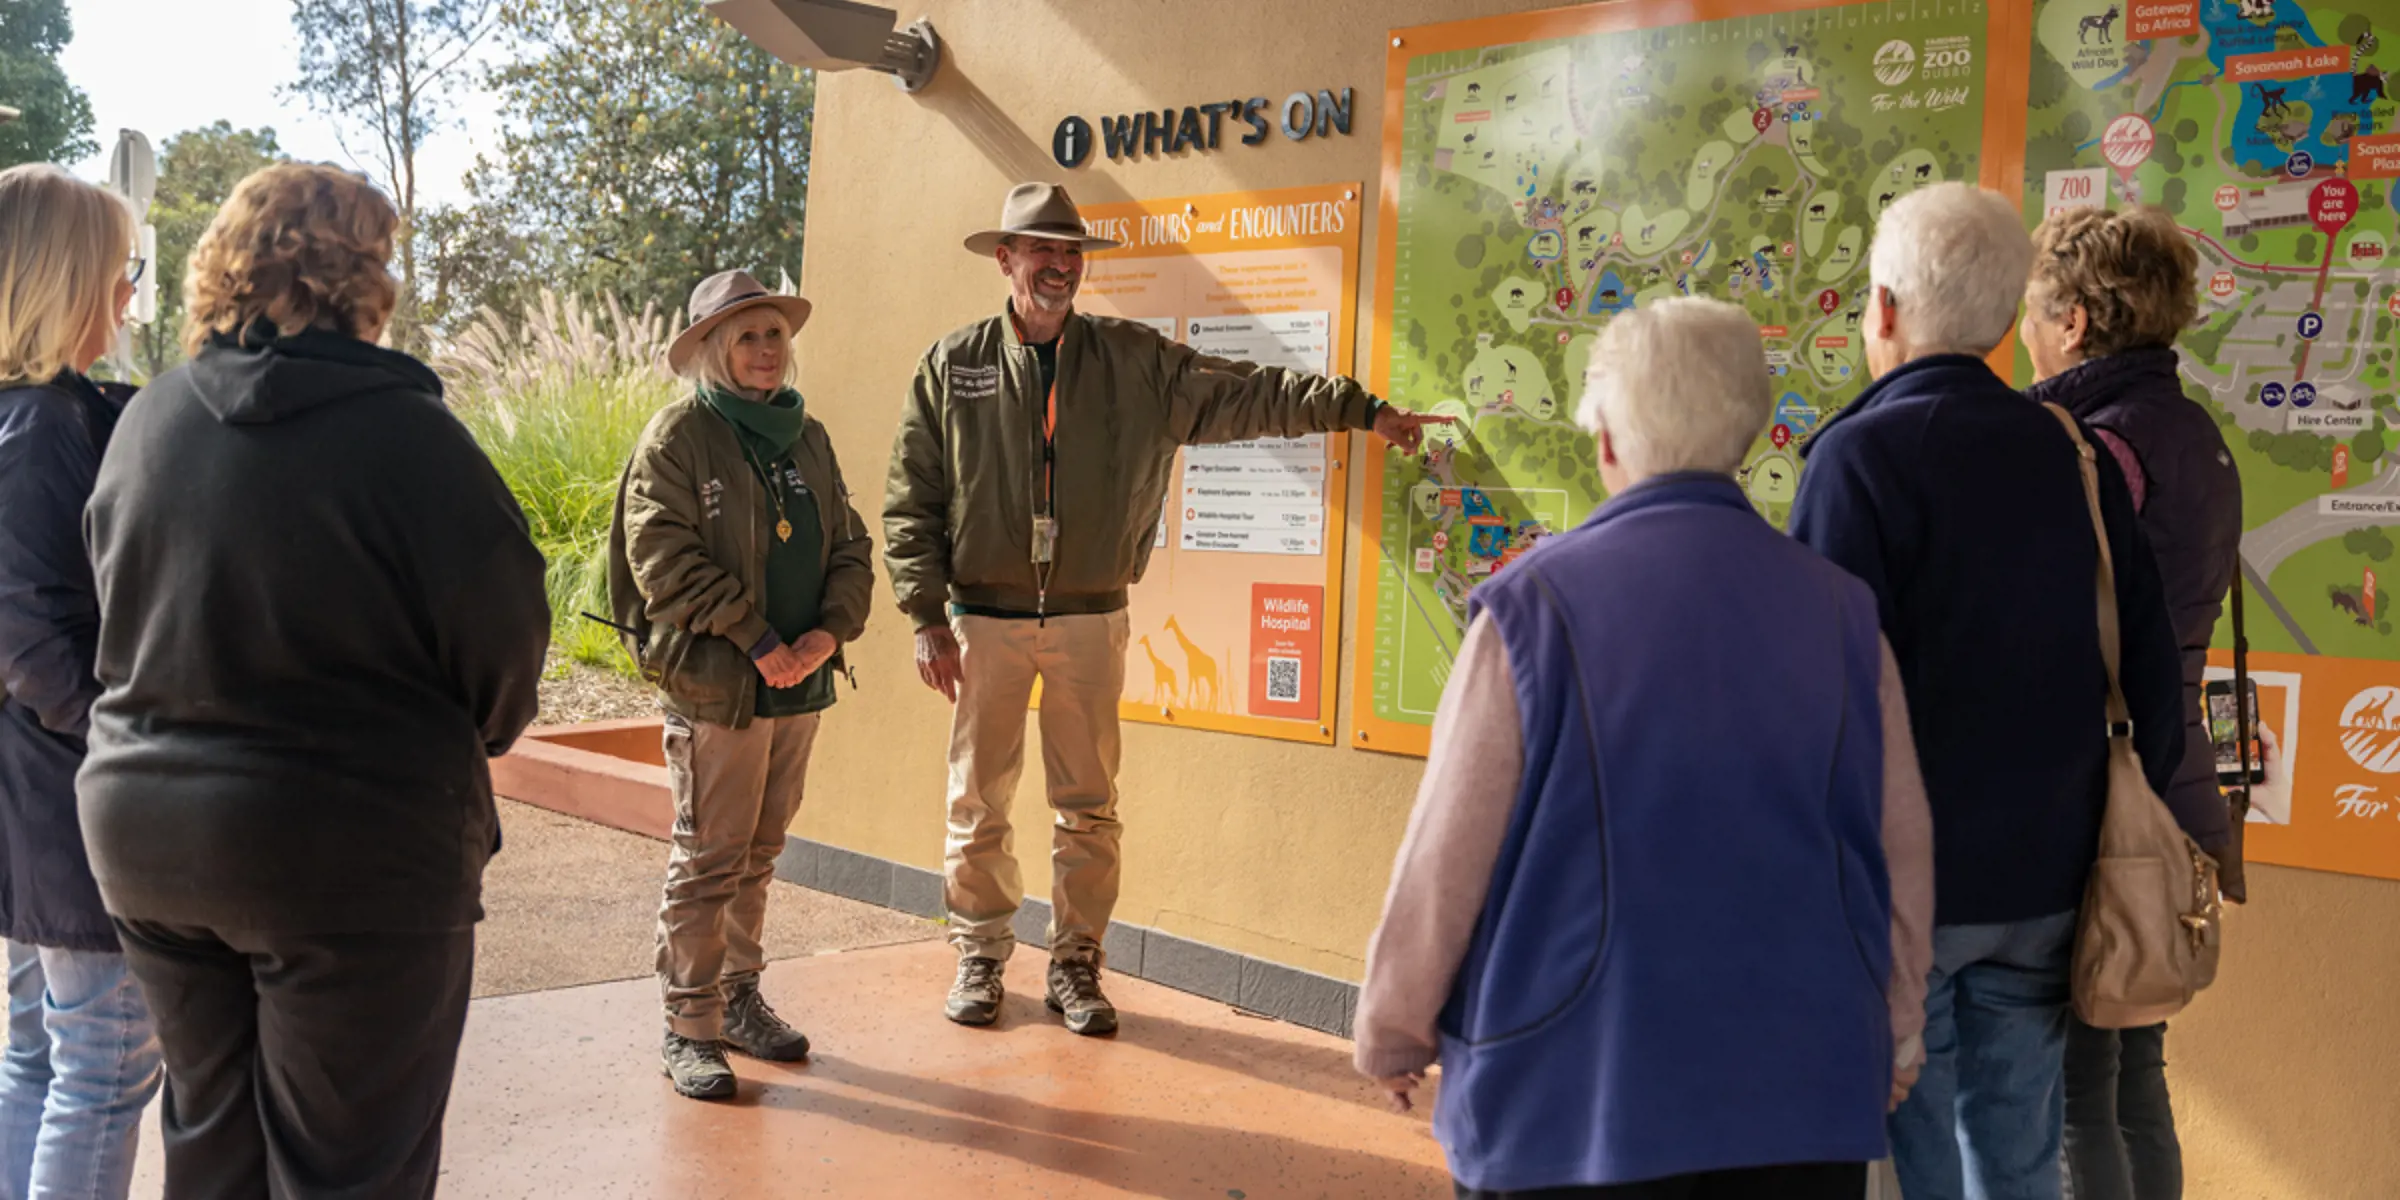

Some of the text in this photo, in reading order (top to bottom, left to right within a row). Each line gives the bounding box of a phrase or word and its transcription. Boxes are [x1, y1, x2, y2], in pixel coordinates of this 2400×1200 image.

[2135, 3, 2193, 18] Gateway
[2135, 18, 2191, 33] to Africa
[1923, 49, 1971, 68] ZOO
[2071, 58, 2119, 70] Wild Dog
[2235, 54, 2340, 75] Savannah Lake
[1870, 86, 1969, 115] For the Wild
[1101, 87, 1353, 160] WHAT'S ON
[2059, 176, 2092, 200] ZOO
[2322, 184, 2346, 197] You
[2323, 199, 2344, 209] are
[1140, 212, 1192, 246] TOURS
[1196, 212, 1225, 234] and
[1230, 200, 1345, 240] ENCOUNTERS
[2318, 210, 2347, 222] here
[2297, 415, 2363, 426] Hire Centre
[1264, 597, 1309, 614] Wildlife
[1261, 615, 1311, 633] Hospital
[2333, 784, 2389, 819] For
